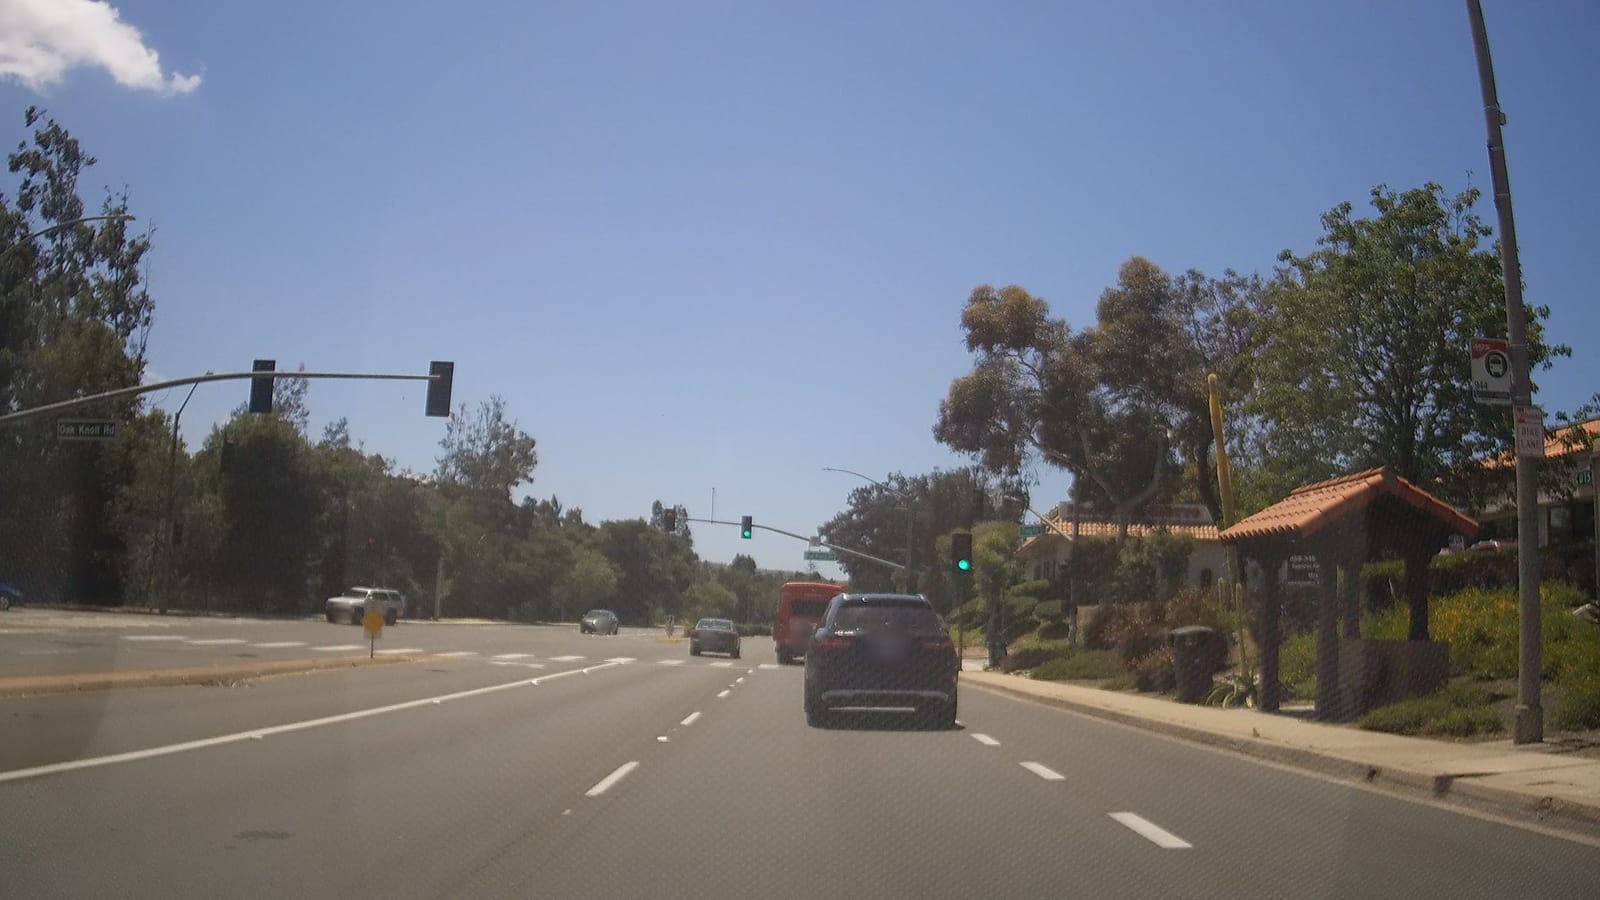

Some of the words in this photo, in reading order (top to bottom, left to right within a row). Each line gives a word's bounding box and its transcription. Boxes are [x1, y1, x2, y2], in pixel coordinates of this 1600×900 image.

[60, 423, 75, 435] Oak
[78, 423, 100, 435] Knoll
[103, 423, 115, 435] Rd
